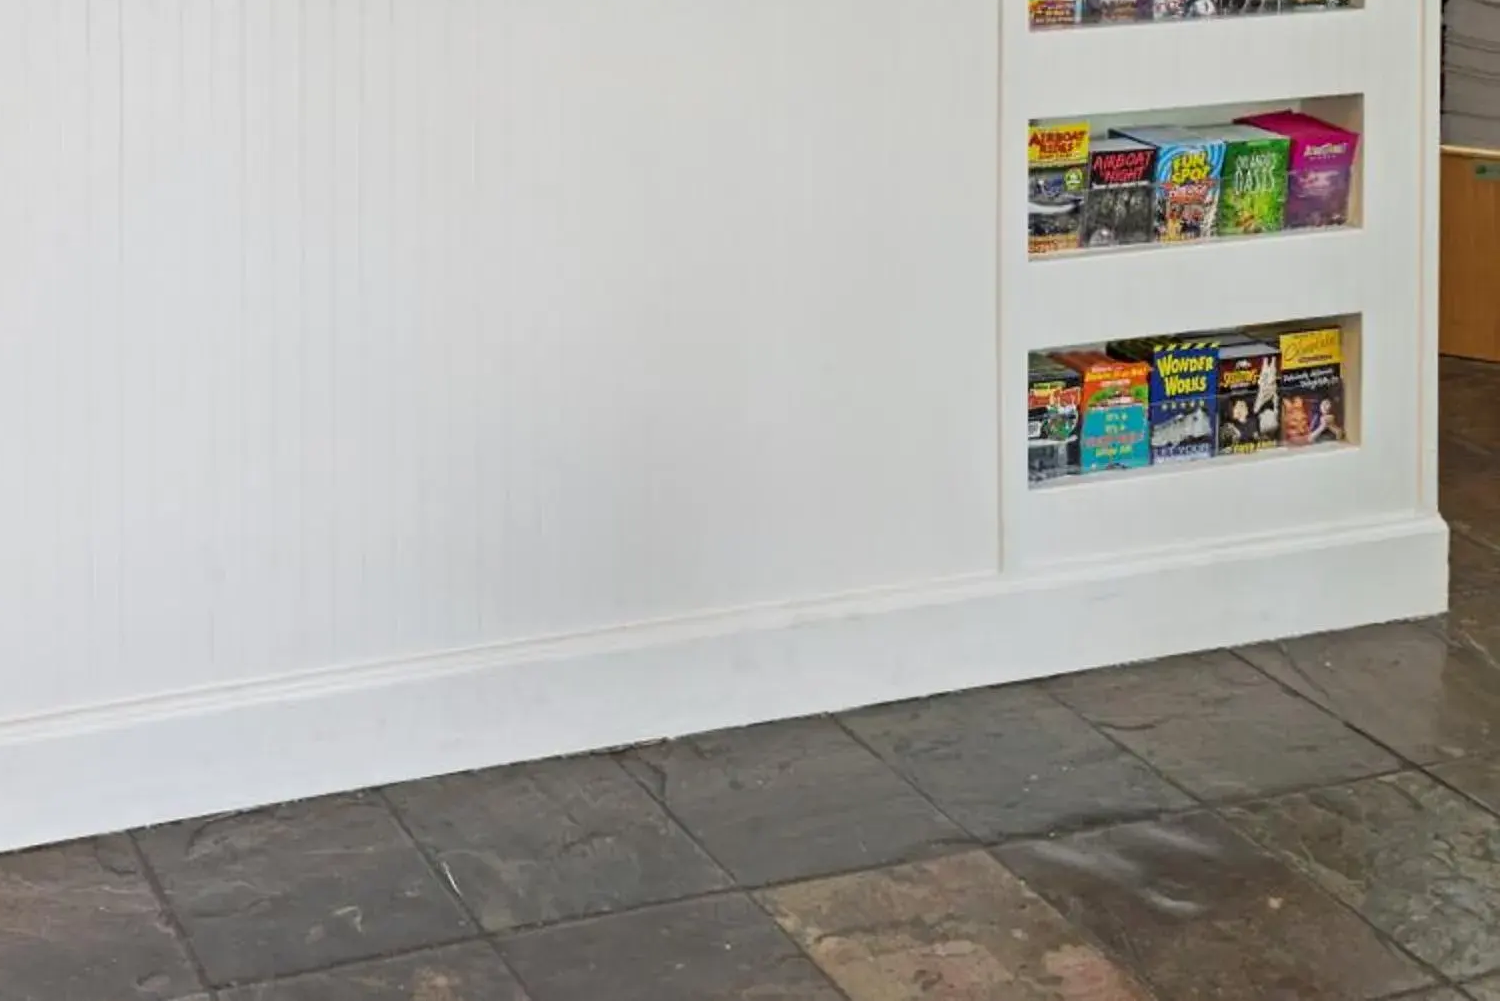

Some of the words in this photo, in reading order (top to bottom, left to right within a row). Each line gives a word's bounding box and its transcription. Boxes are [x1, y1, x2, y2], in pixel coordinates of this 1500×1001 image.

[1029, 130, 1086, 146] AIRBOAT
[1093, 150, 1154, 170] AIRBOAT
[1173, 151, 1208, 170] FUN
[1171, 166, 1211, 183] SPOT
[1157, 354, 1214, 377] WONDER
[1164, 374, 1208, 396] WORKS
